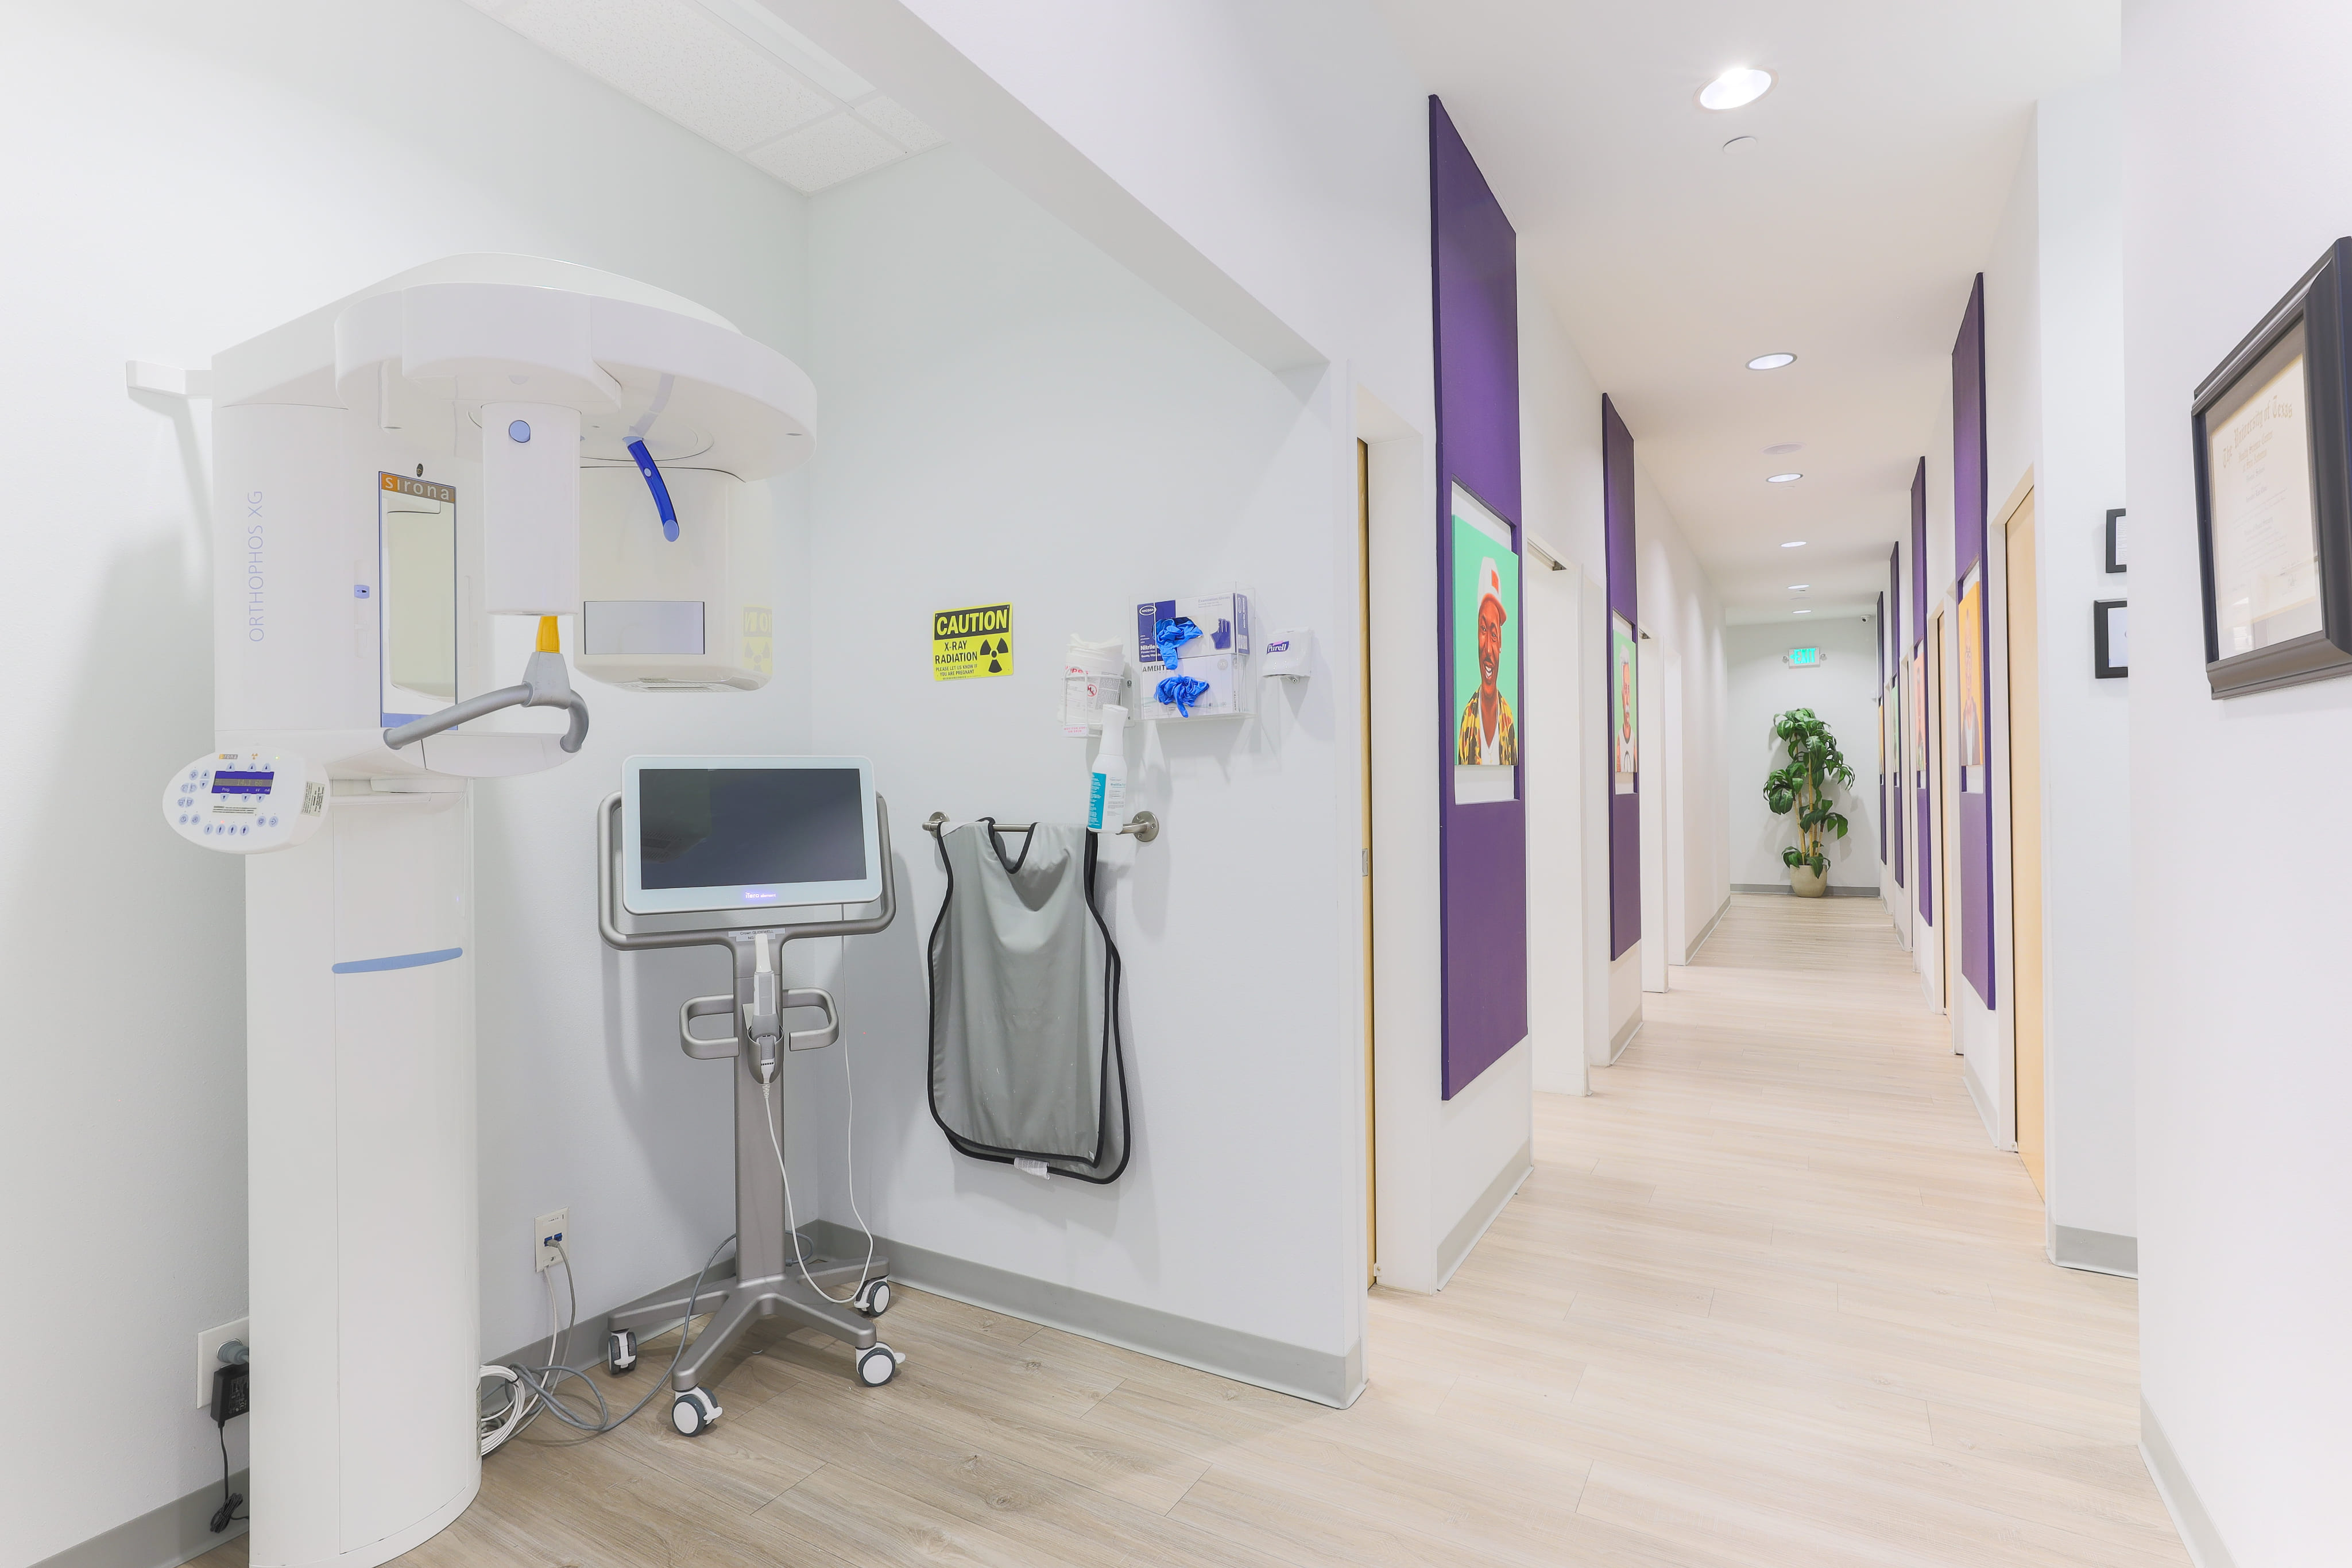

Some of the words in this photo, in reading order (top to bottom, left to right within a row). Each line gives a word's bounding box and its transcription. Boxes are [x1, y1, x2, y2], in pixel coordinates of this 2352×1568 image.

[2223, 445, 2233, 469] The
[2234, 409, 2263, 449] University
[2264, 400, 2270, 421] of
[2272, 395, 2292, 418] Texas
[385, 477, 449, 500] sirona
[247, 491, 262, 518] XG
[247, 525, 264, 642] ORTHOPHOS
[937, 609, 1007, 636] CAUTION
[945, 640, 967, 651] X-RAY
[1268, 644, 1287, 652] Purell
[1794, 648, 1816, 664] EXIT
[935, 652, 977, 664] RADIATION
